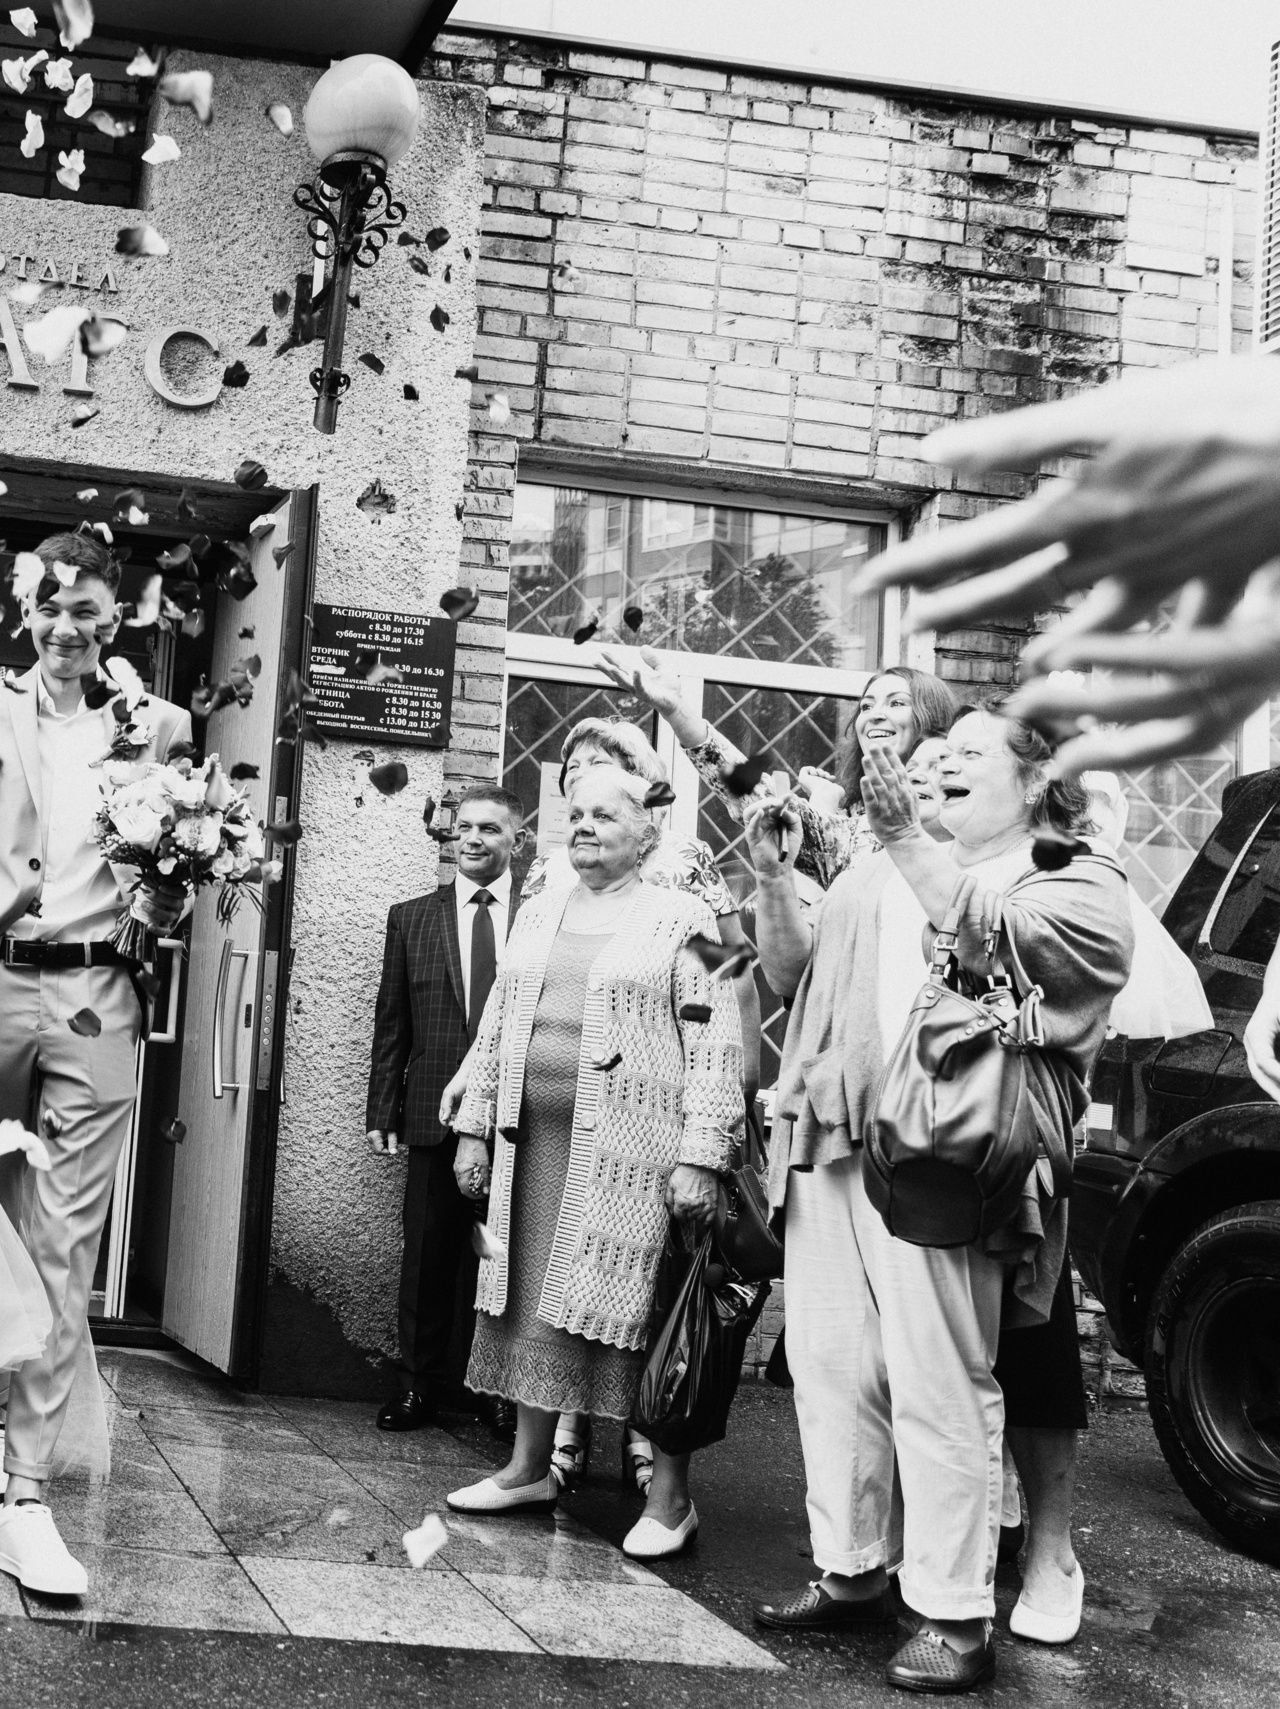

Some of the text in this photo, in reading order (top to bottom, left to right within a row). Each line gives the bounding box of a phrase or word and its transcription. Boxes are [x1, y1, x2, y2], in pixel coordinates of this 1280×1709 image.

[331, 607, 431, 626] РАСПОРЯДОК РАБОТЫ
[375, 623, 391, 632] 8.30
[404, 626, 425, 636] 17.30
[335, 630, 366, 639] суббота
[374, 633, 391, 642] 8.30
[403, 636, 424, 646] 16.15
[311, 646, 350, 657] ВТОРНИК
[310, 655, 337, 664] СРЕДА
[411, 667, 422, 675] до
[423, 667, 445, 677] 16.30
[312, 680, 355, 689] РЕГИСТРАЦИЮ
[386, 682, 438, 693] ТОРЖЕСТВЕННУЮ
[391, 696, 408, 706] 8.30
[421, 700, 442, 710] 16.30
[306, 710, 339, 719] ОБЕДЕННЫЙ
[340, 714, 365, 722] ПЕРЕРЫВ
[386, 716, 407, 726] 13.00
[391, 706, 408, 716] 8.30
[408, 710, 419, 718] до
